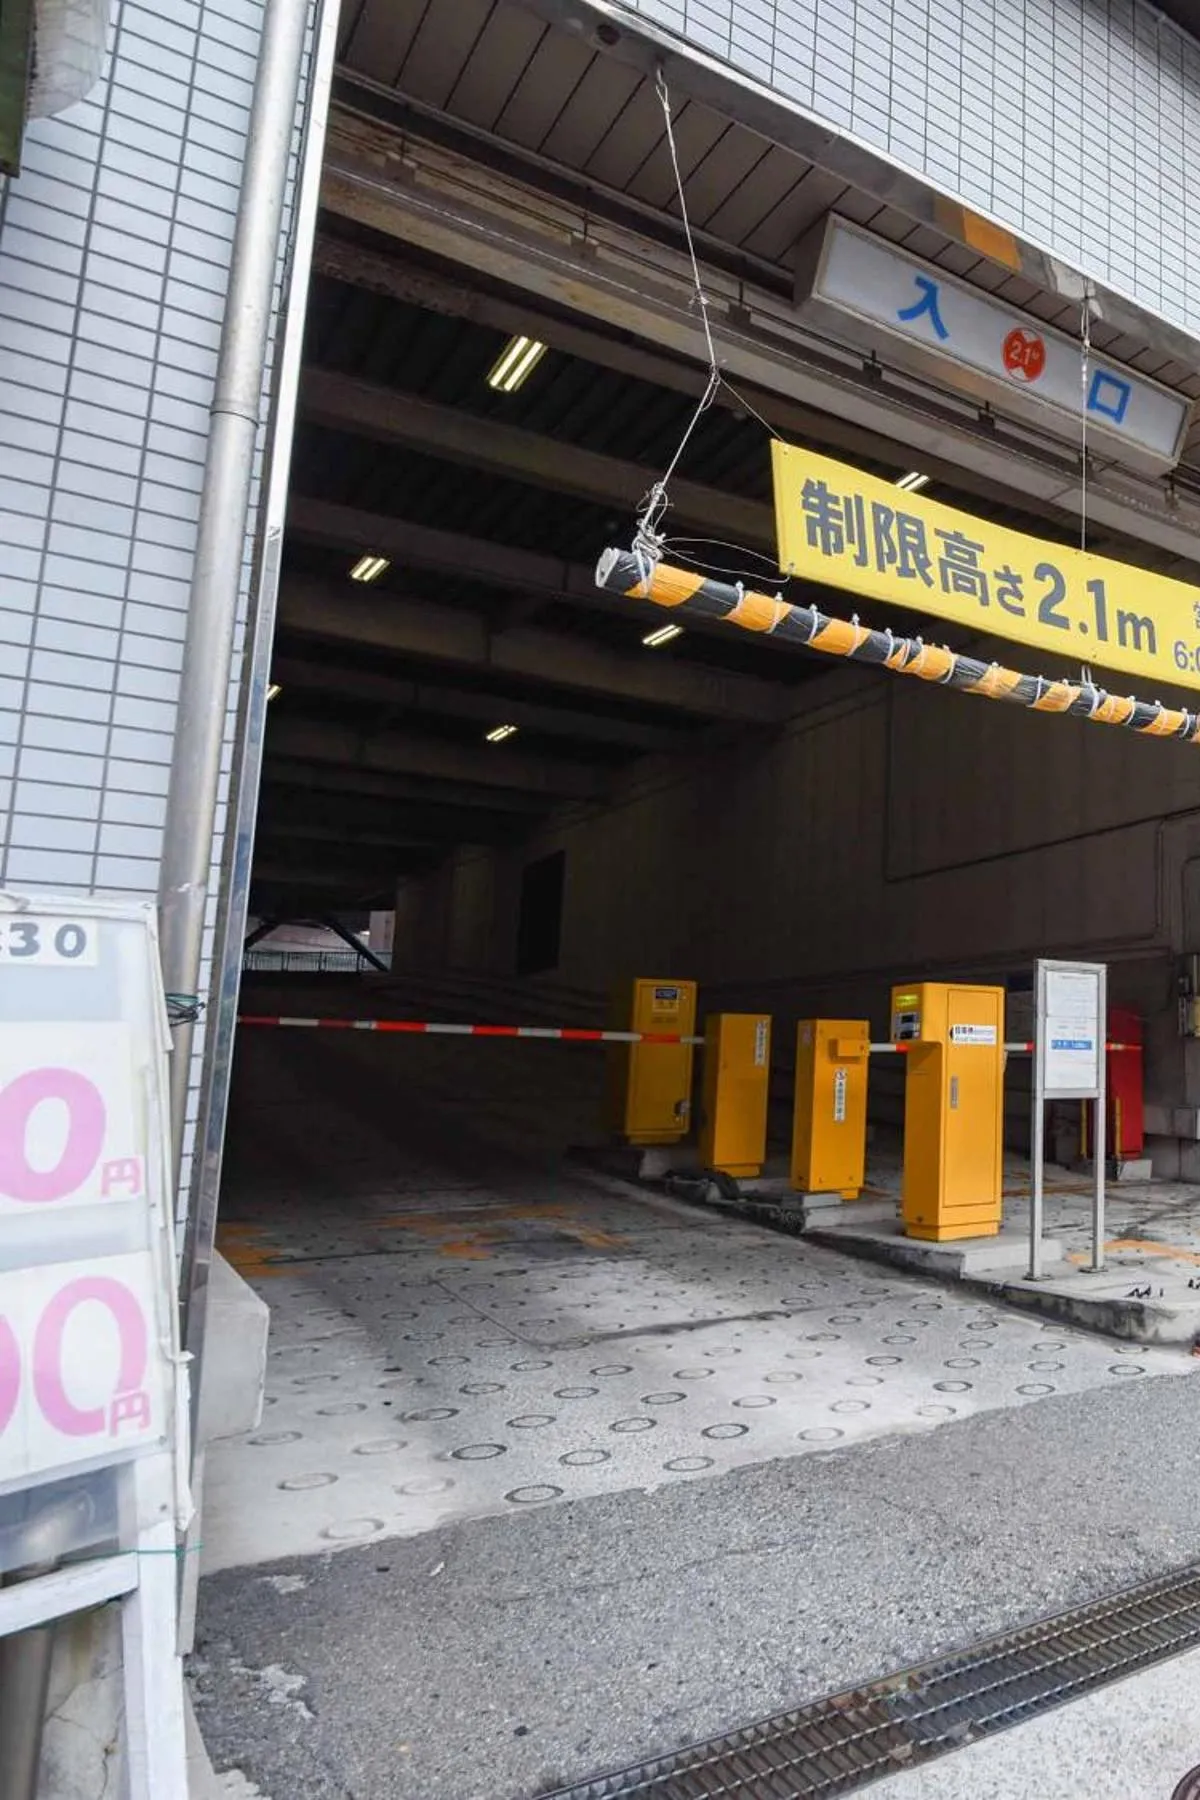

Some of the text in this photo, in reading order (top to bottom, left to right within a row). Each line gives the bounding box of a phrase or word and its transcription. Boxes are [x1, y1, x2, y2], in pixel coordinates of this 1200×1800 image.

[897, 275, 950, 341] 入
[1086, 369, 1132, 425] 口
[800, 477, 1158, 655] 制限高さ2.1m
